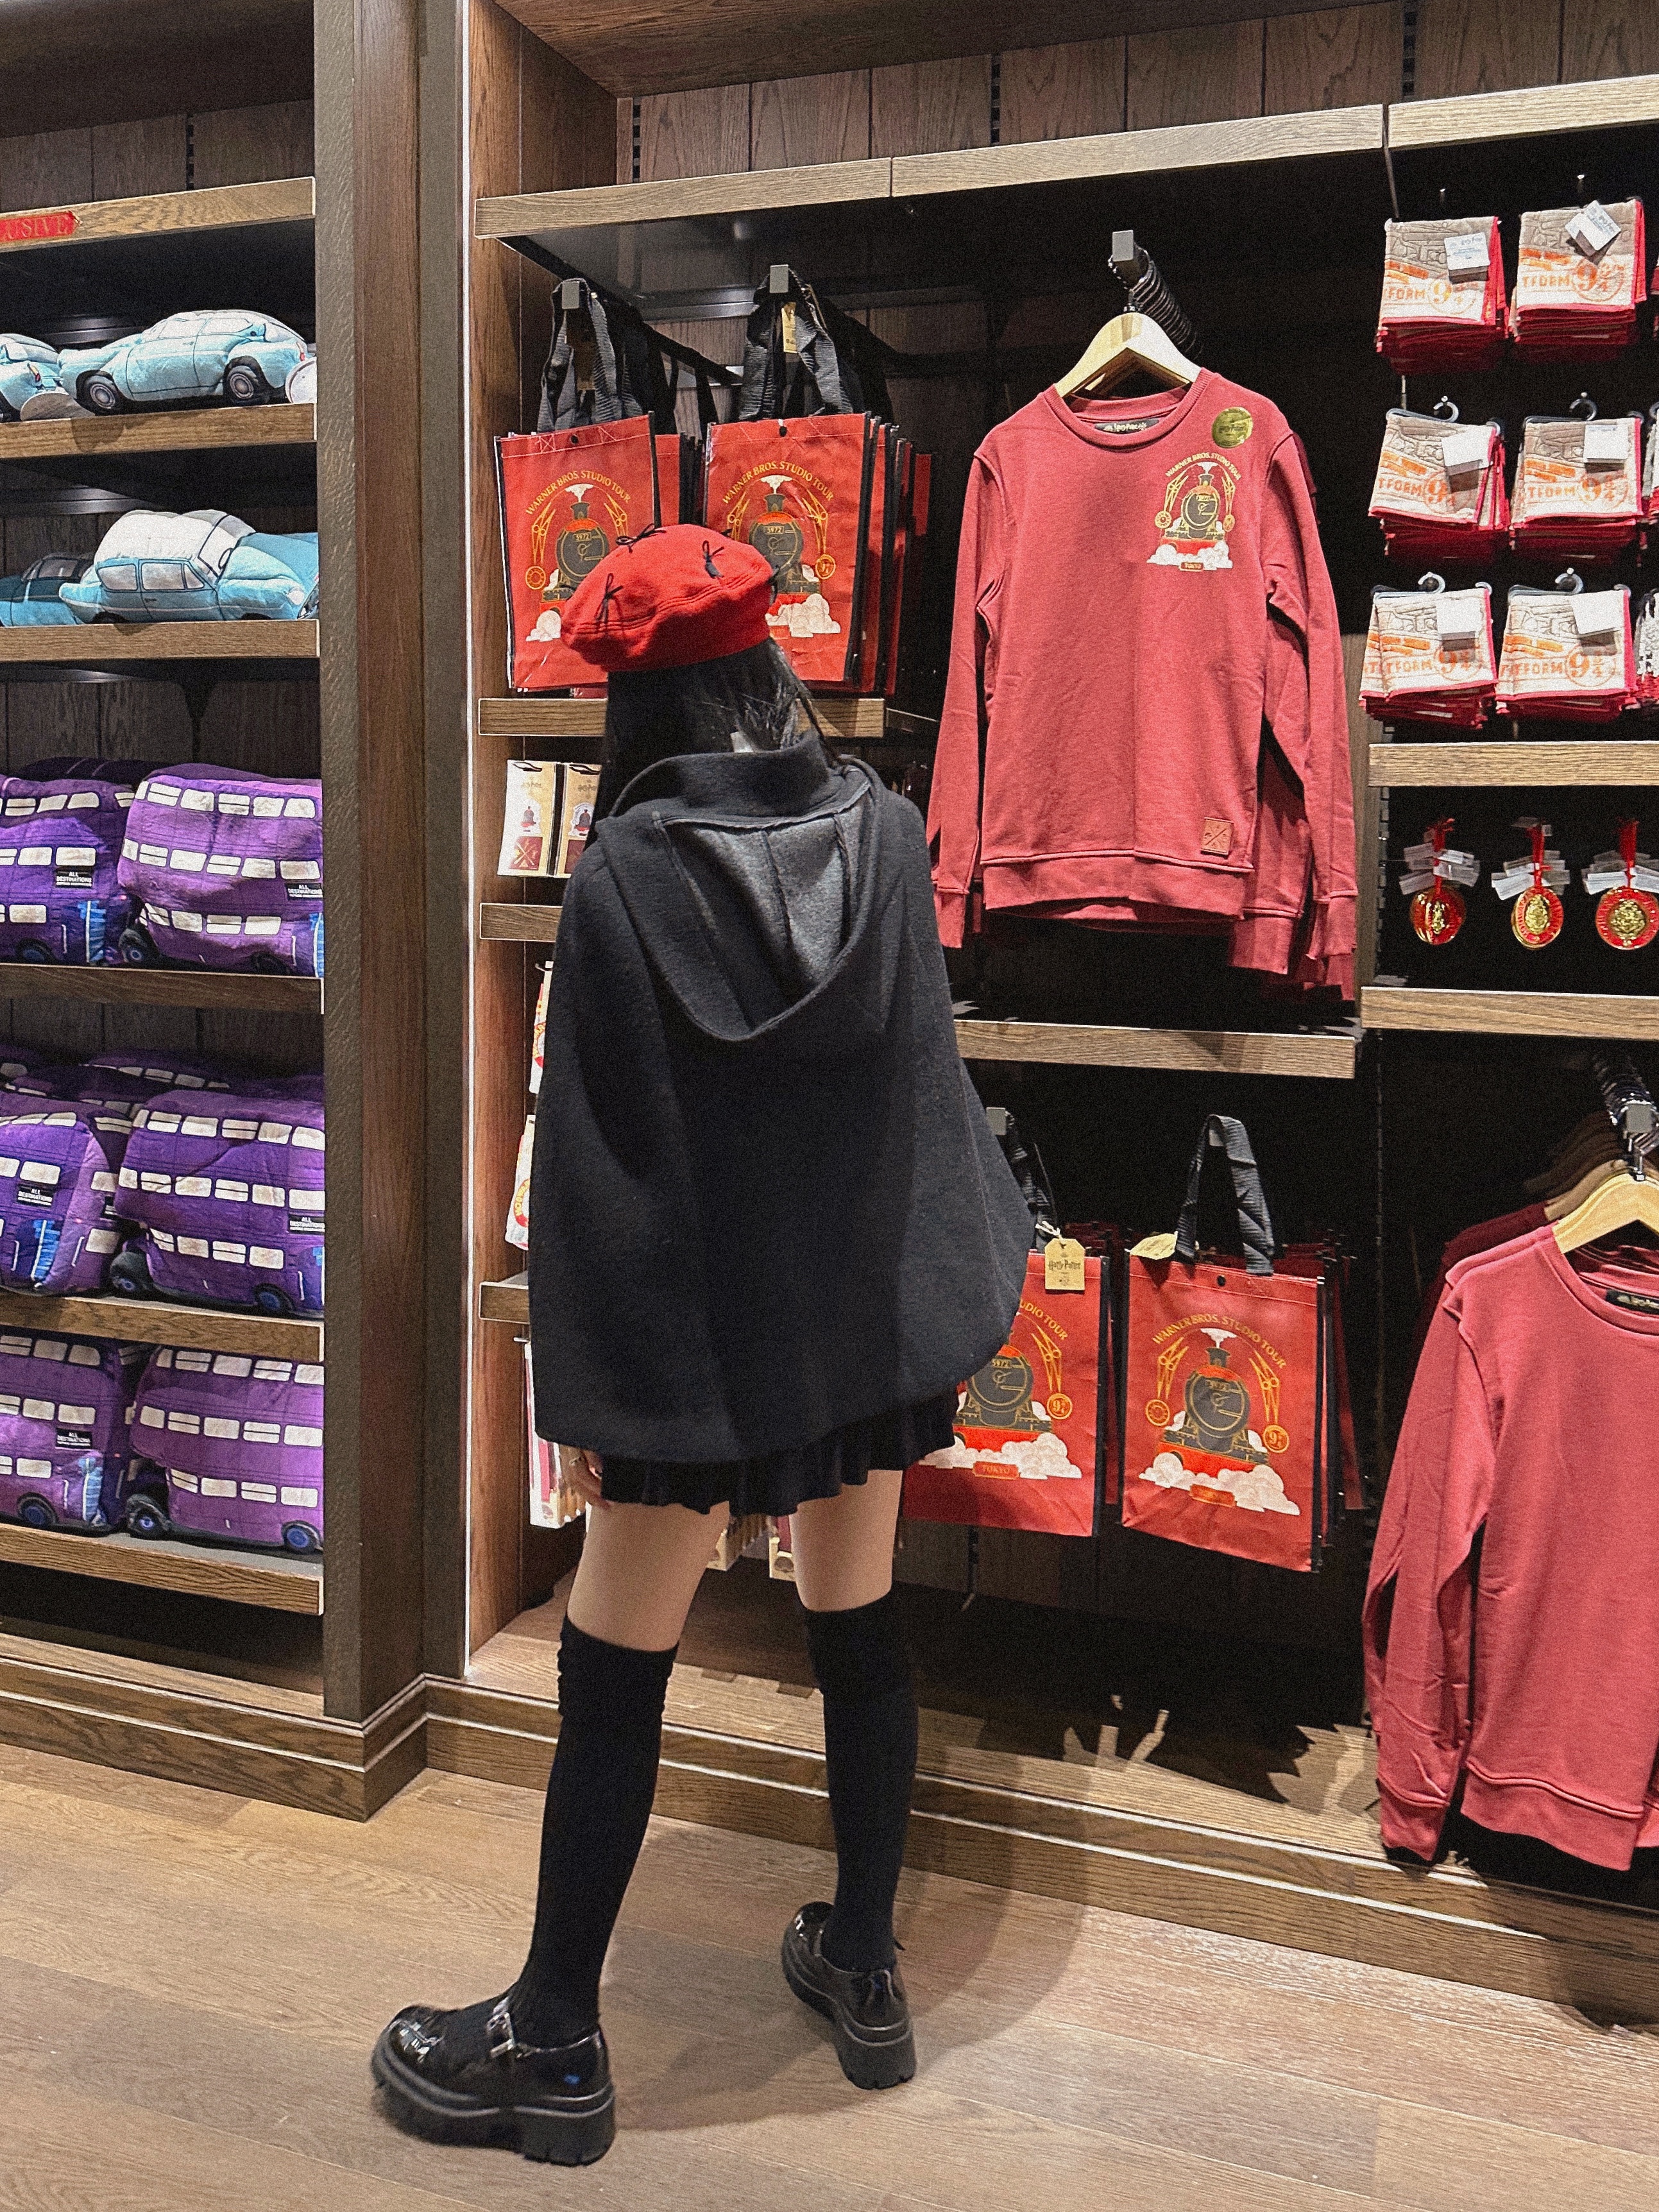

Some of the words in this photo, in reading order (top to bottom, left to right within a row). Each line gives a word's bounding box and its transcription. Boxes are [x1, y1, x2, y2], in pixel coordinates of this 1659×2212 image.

[525, 482, 557, 515] WARNER
[581, 470, 611, 487] STUDIO
[611, 482, 631, 504] TOUR
[722, 471, 753, 504] WARNER
[779, 461, 813, 482] STUDIO
[812, 477, 834, 501] TOUR
[1020, 1298, 1044, 1317] UDIO
[1044, 1315, 1068, 1341] TOUR
[1221, 1316, 1261, 1343] STUDIO
[1261, 1340, 1287, 1369] TOUR
